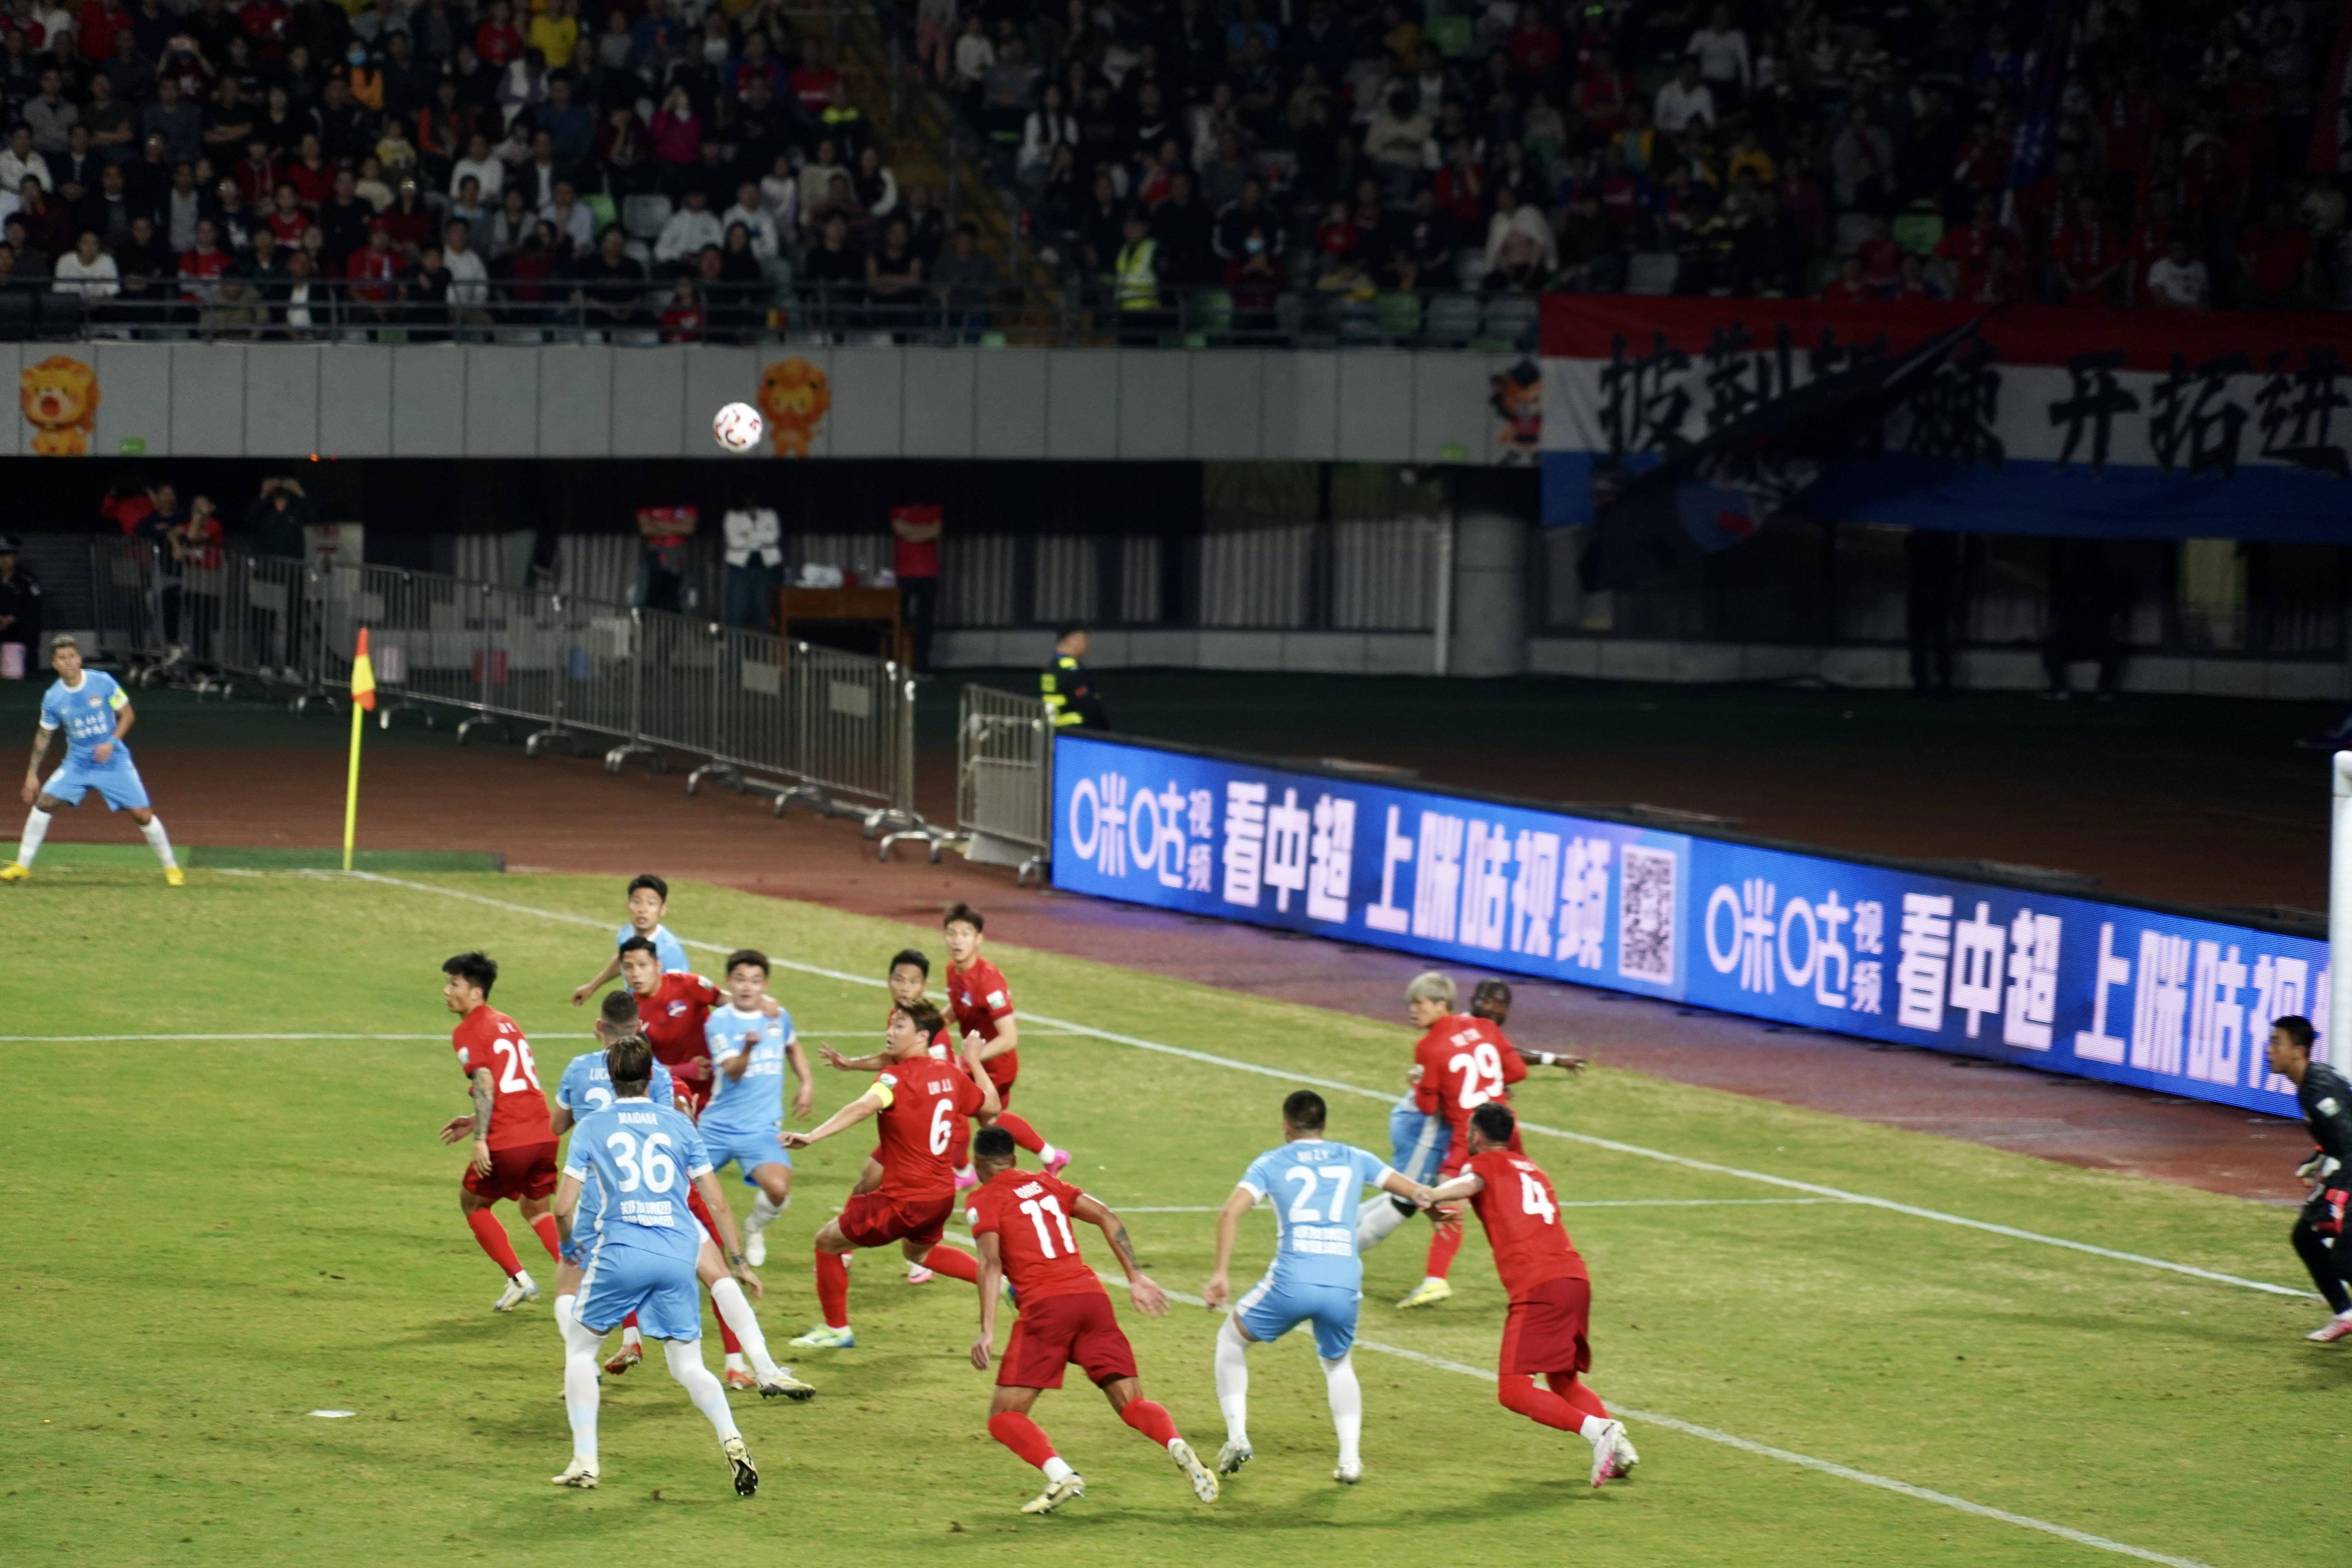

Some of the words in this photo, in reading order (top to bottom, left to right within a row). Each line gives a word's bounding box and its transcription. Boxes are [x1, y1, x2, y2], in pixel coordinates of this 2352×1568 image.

[1598, 321, 2005, 470] 披荆棘
[1222, 781, 1356, 923] 看中超
[1365, 804, 1611, 970] 上咪咕视频
[1897, 893, 2062, 1052] 看中超
[1448, 1043, 1504, 1109] 29
[929, 1099, 953, 1156] 6
[606, 1131, 675, 1193] 36
[1285, 1165, 1352, 1223] 27
[1020, 1195, 1076, 1259] 11
[1519, 1172, 1556, 1225] 4
